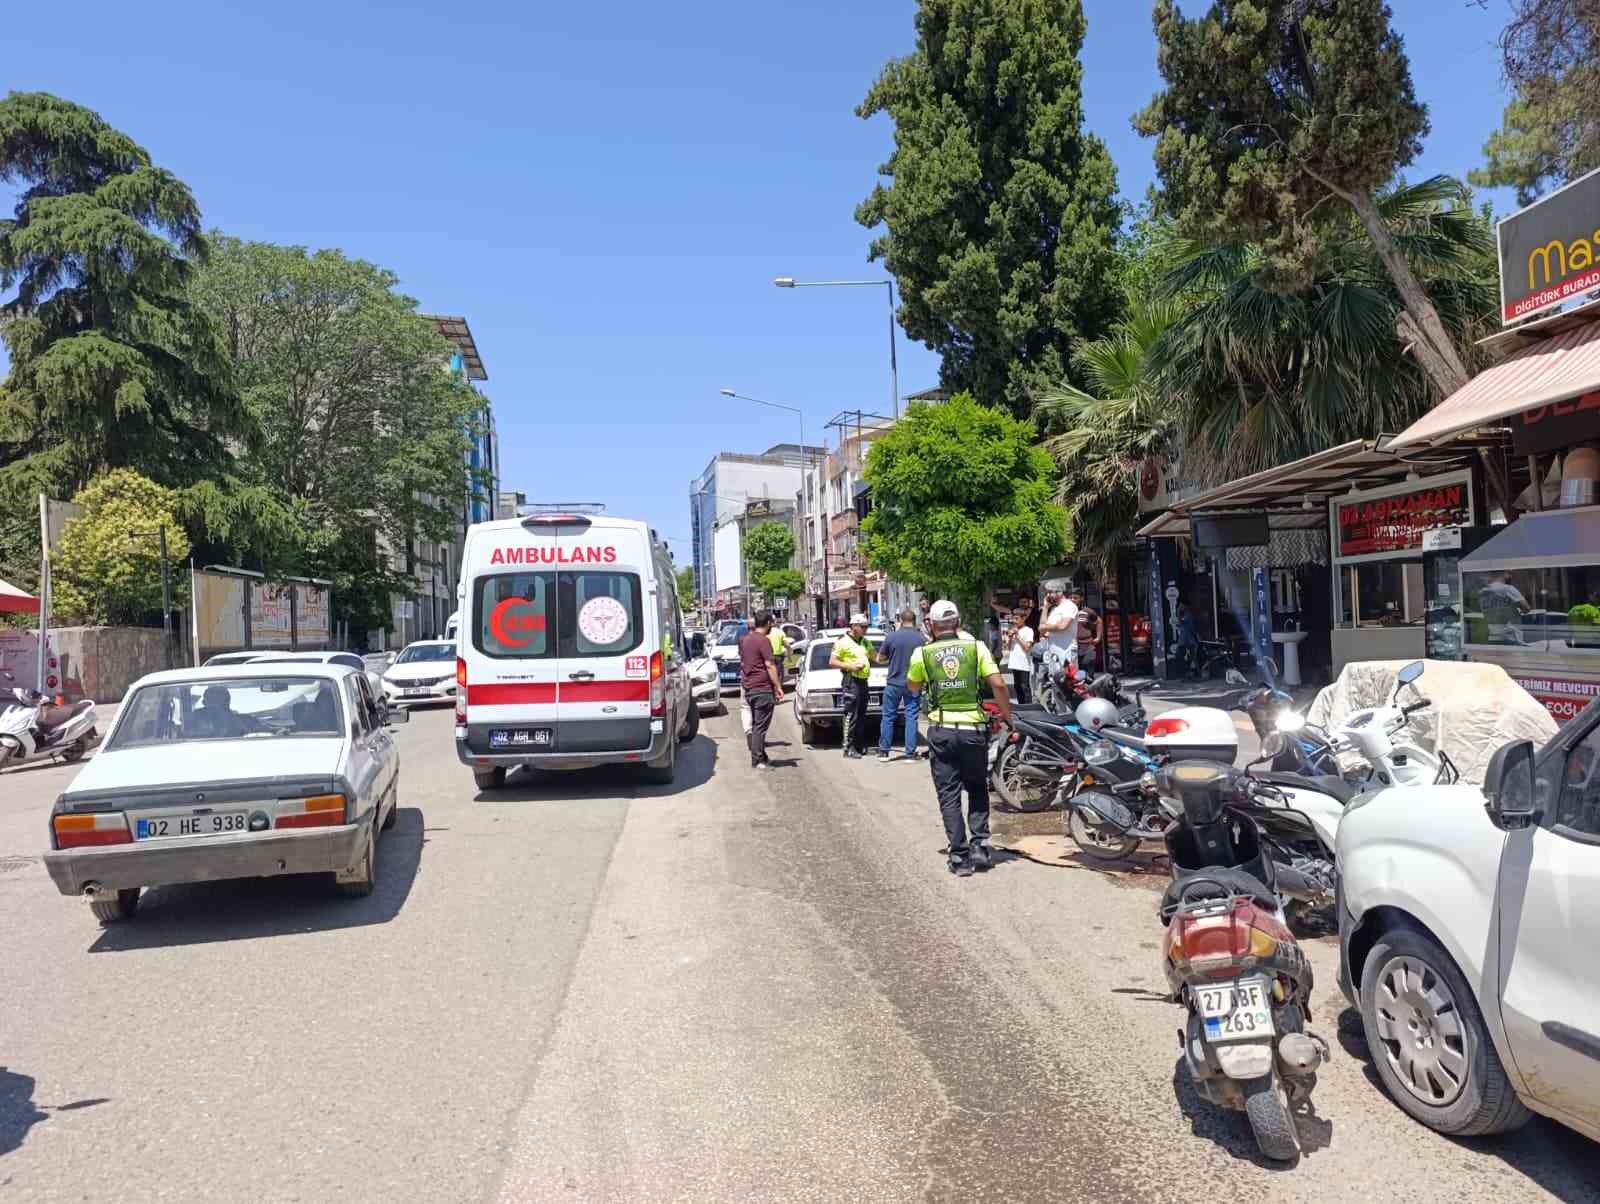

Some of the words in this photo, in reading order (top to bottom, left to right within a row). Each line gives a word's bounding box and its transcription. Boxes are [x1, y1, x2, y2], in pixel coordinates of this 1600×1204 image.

[1514, 287, 1561, 315] DİGİTÜRK
[490, 546, 617, 565] AMBULANS
[628, 658, 645, 669] 112
[147, 820, 169, 837] 02
[180, 818, 202, 834] HE
[212, 815, 245, 832] 938
[1203, 991, 1222, 1011] 27
[1224, 1012, 1256, 1032] 263
